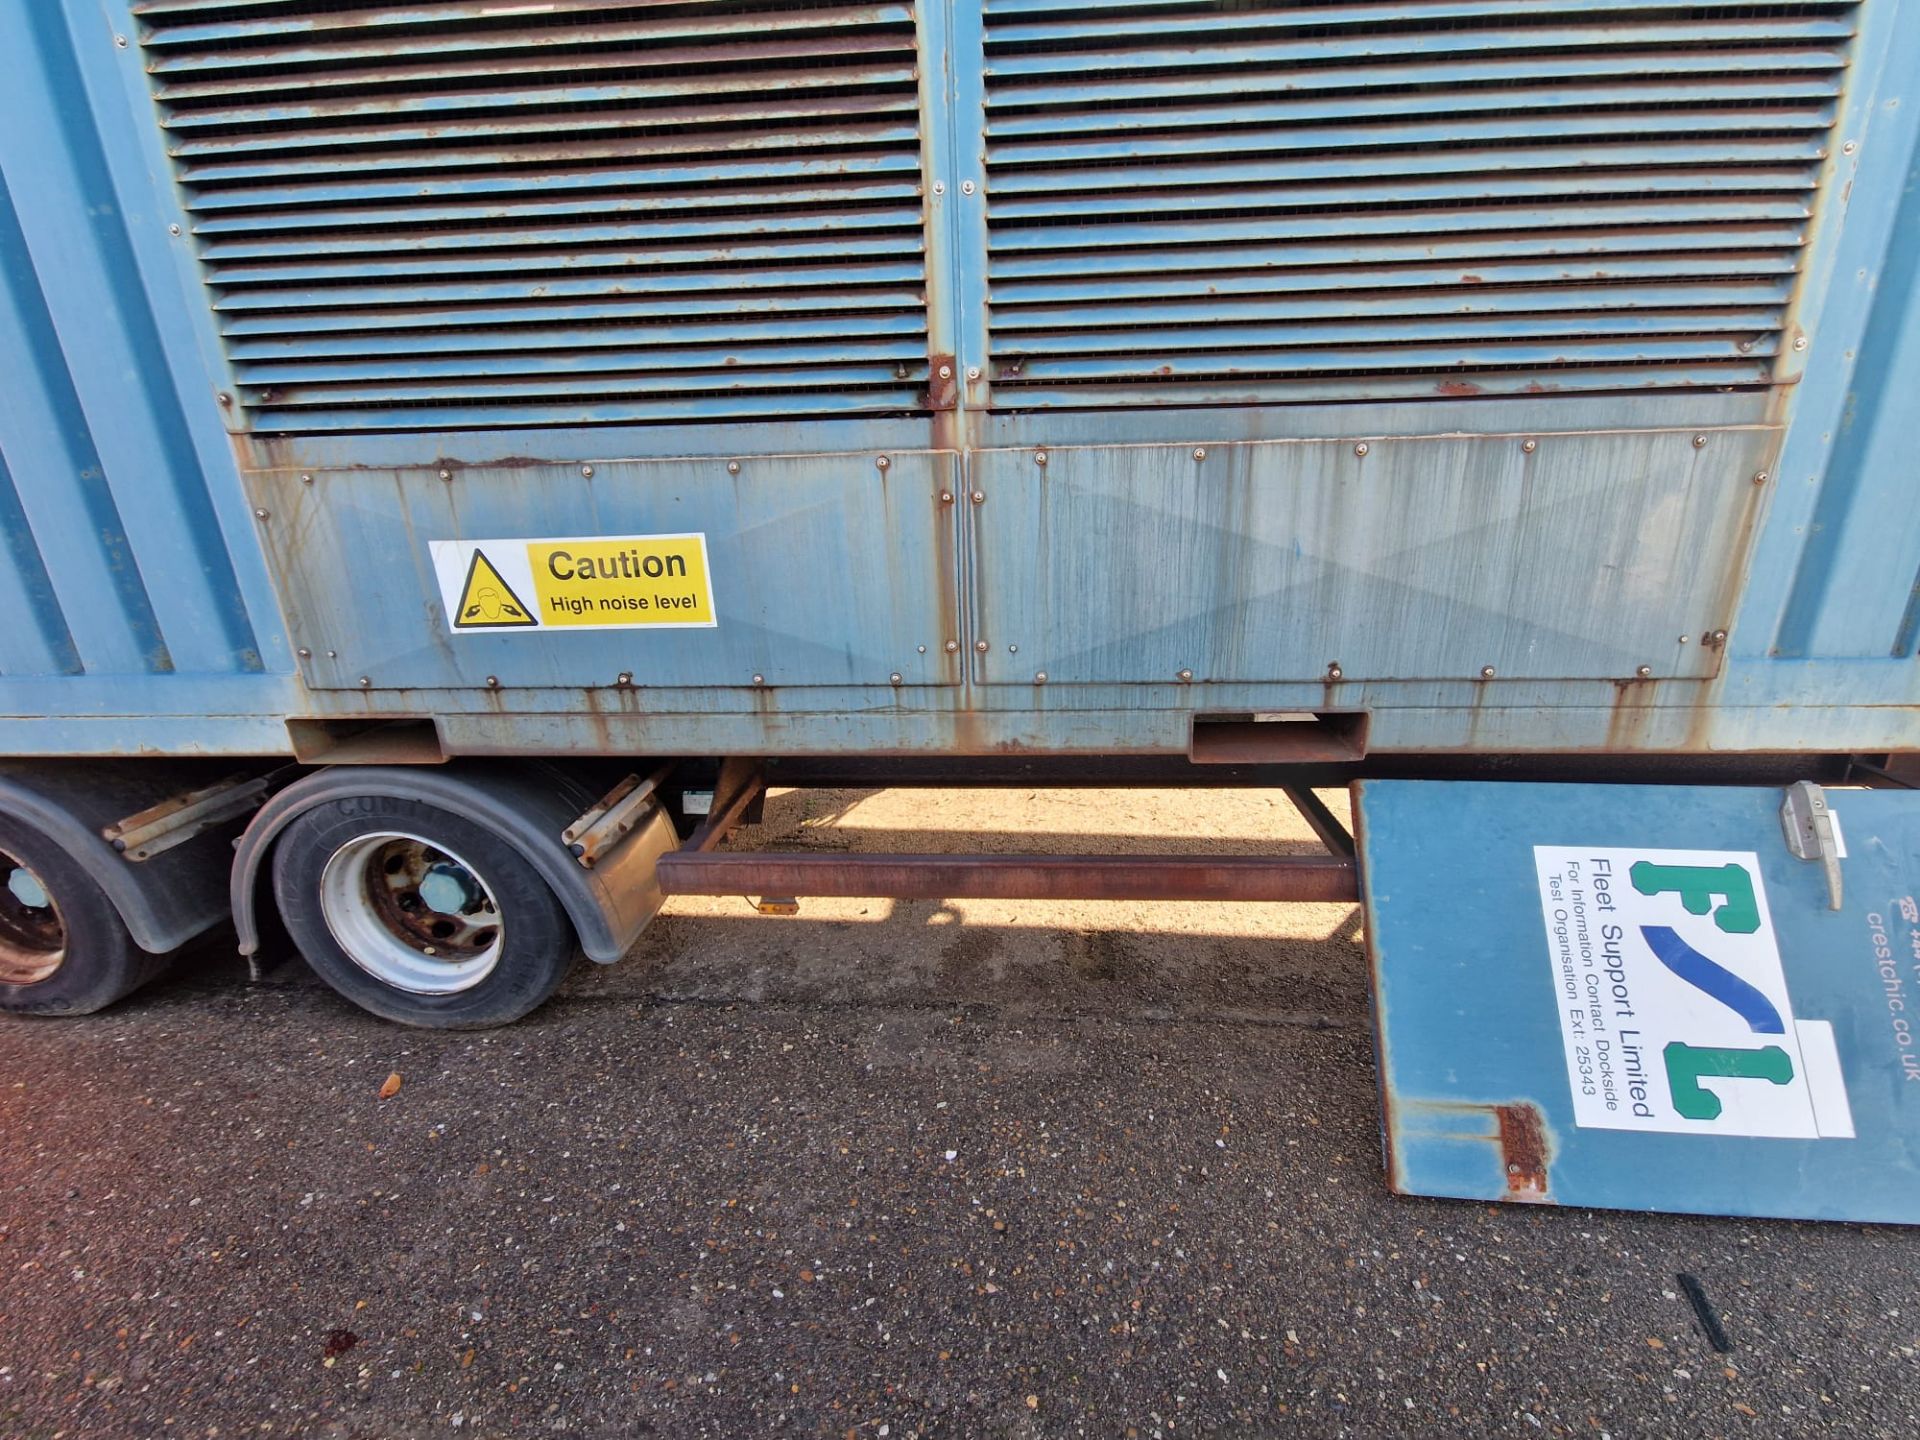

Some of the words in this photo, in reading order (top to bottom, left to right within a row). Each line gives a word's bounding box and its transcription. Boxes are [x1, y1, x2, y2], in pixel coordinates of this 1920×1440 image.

[548, 549, 686, 581] Caution
[550, 596, 594, 615] High
[600, 595, 649, 610] noise
[654, 593, 697, 609] level
[1549, 873, 1563, 902] Test
[1566, 860, 1580, 884] For
[1590, 858, 1616, 912] Fleet
[1554, 908, 1578, 1000] Organisation
[1571, 889, 1594, 967] Information
[1601, 924, 1635, 1017] Support
[1867, 912, 1920, 1081] crestchic.co.uk
[1570, 1008, 1587, 1040] Ext:
[1585, 973, 1606, 1032] Contact
[1575, 1045, 1596, 1096] 25343
[1595, 1039, 1618, 1112] Dockside
[1619, 1029, 1655, 1118] Limited
